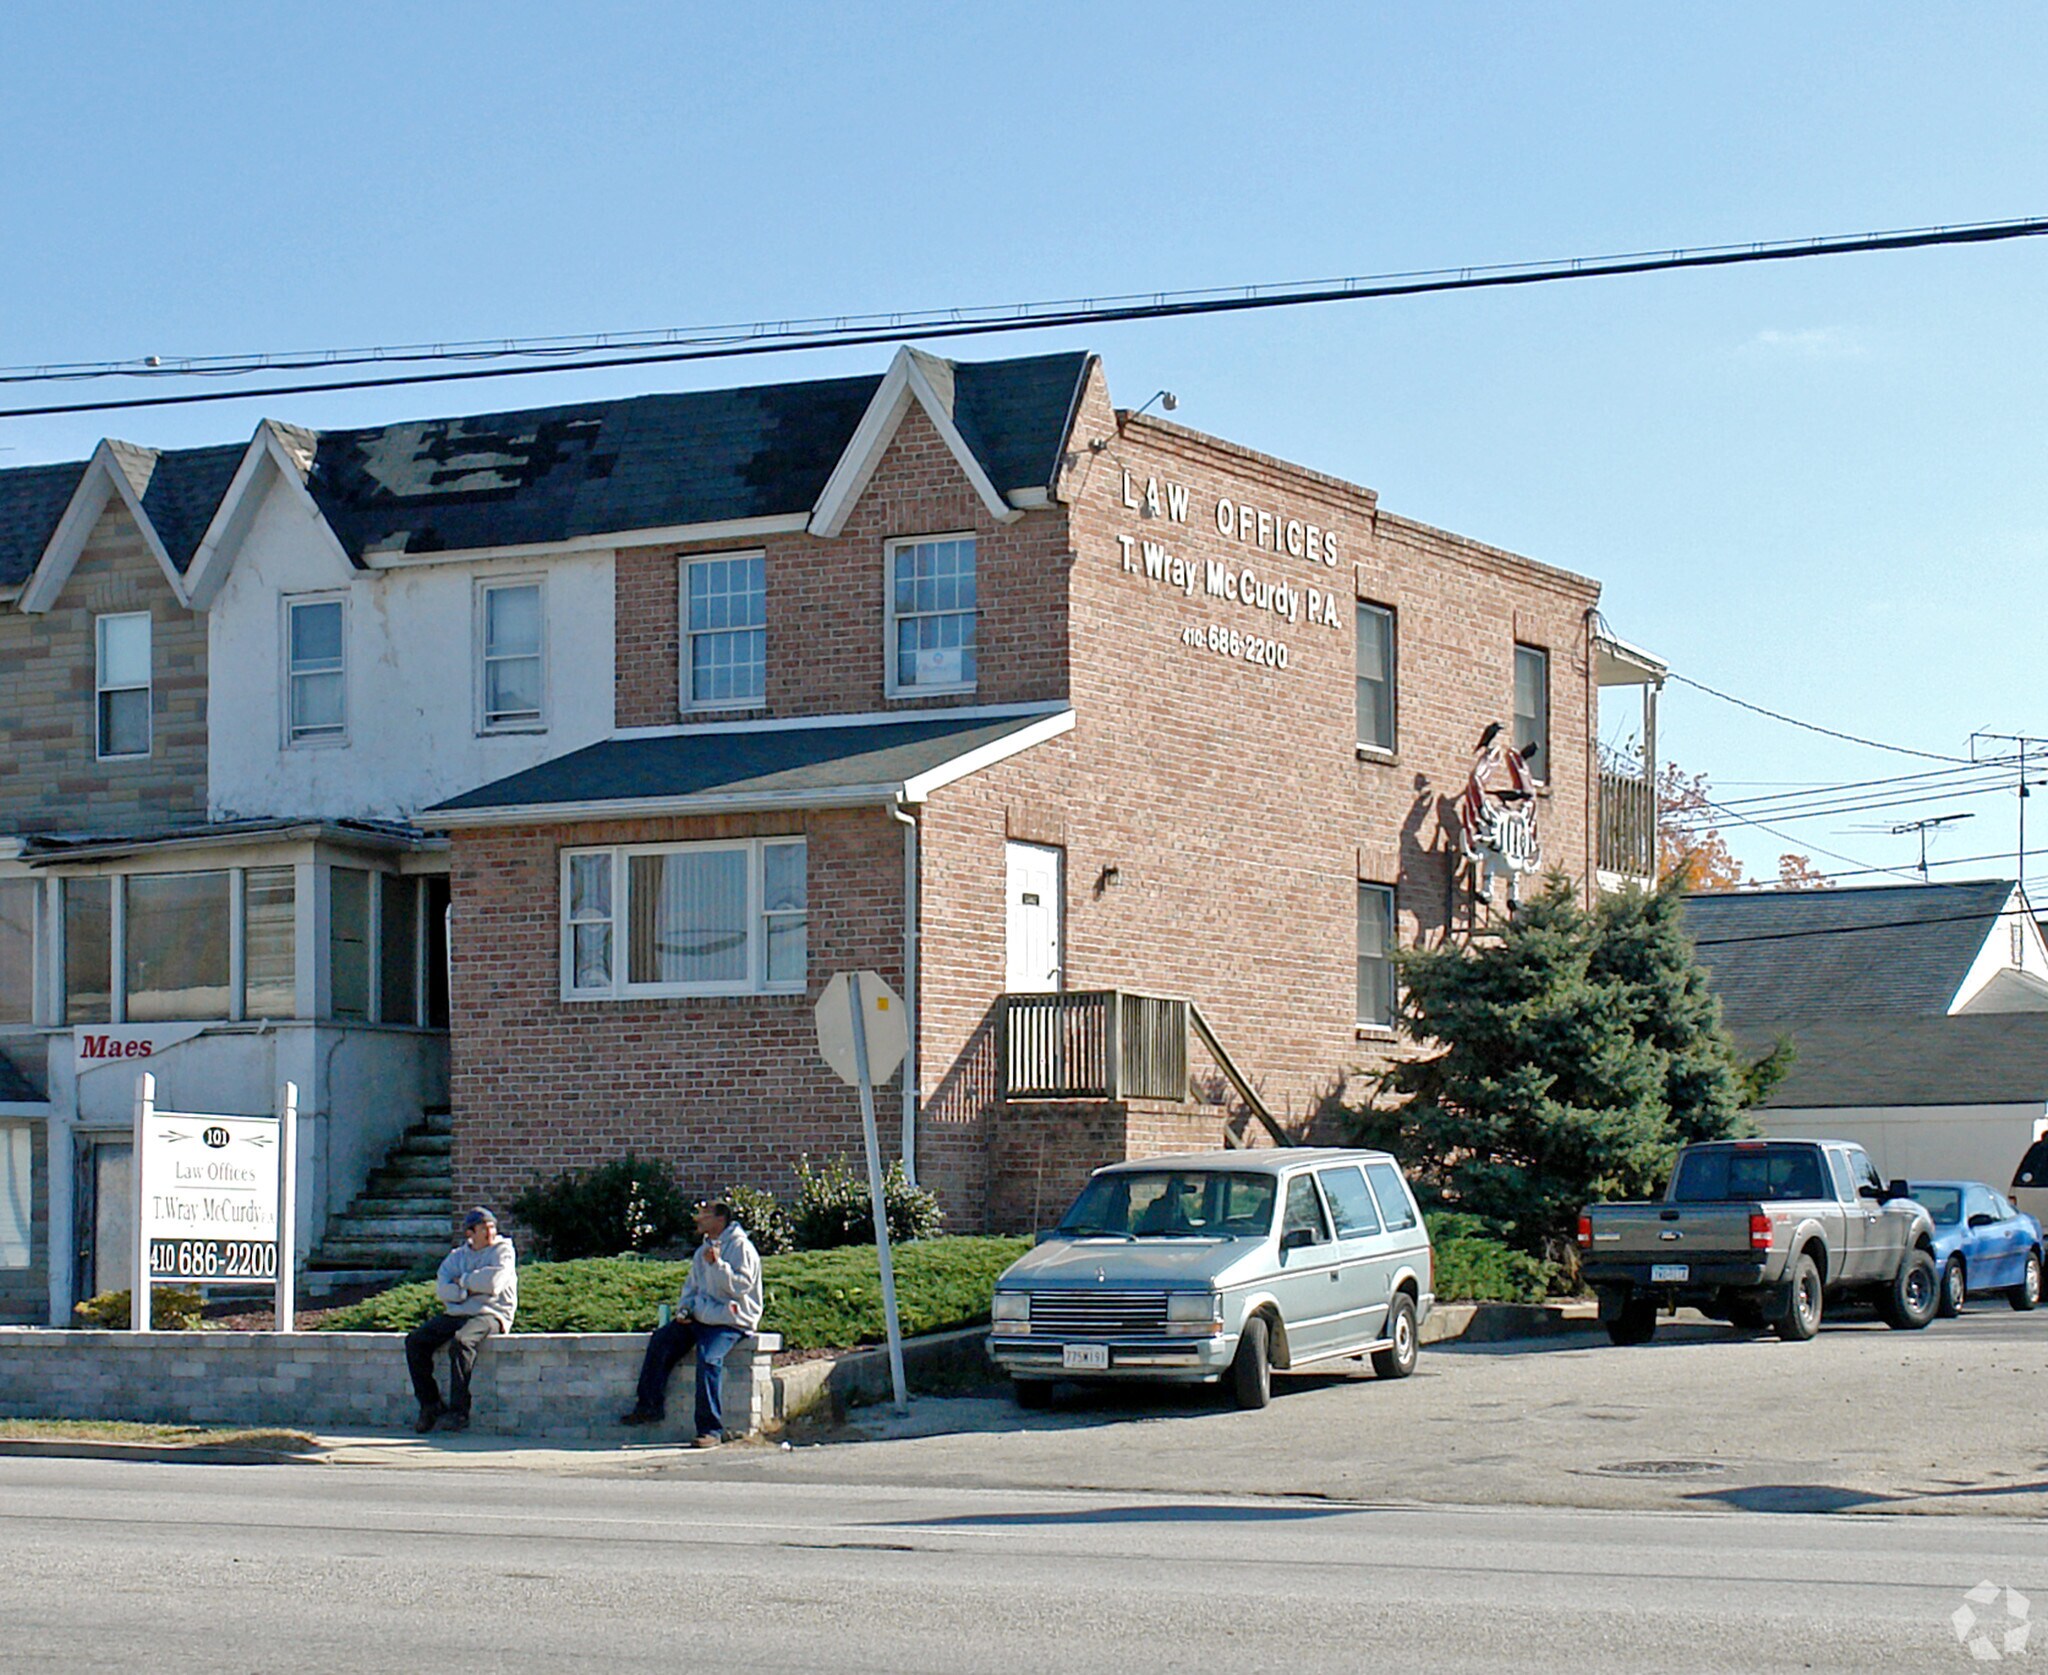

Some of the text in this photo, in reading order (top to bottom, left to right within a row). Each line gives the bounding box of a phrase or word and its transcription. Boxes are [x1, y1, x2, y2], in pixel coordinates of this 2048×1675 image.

[1123, 469, 1338, 567] LAW OFFICES
[1142, 541, 1197, 596] Wray
[1205, 559, 1299, 623] McCurdy
[1307, 588, 1342, 629] P.A.
[80, 1035, 153, 1058] Maes
[207, 1129, 227, 1145] 101
[176, 1161, 255, 1181] Law Offices
[203, 1198, 261, 1230] McCurdy
[150, 1241, 277, 1276] 410 686-2200
